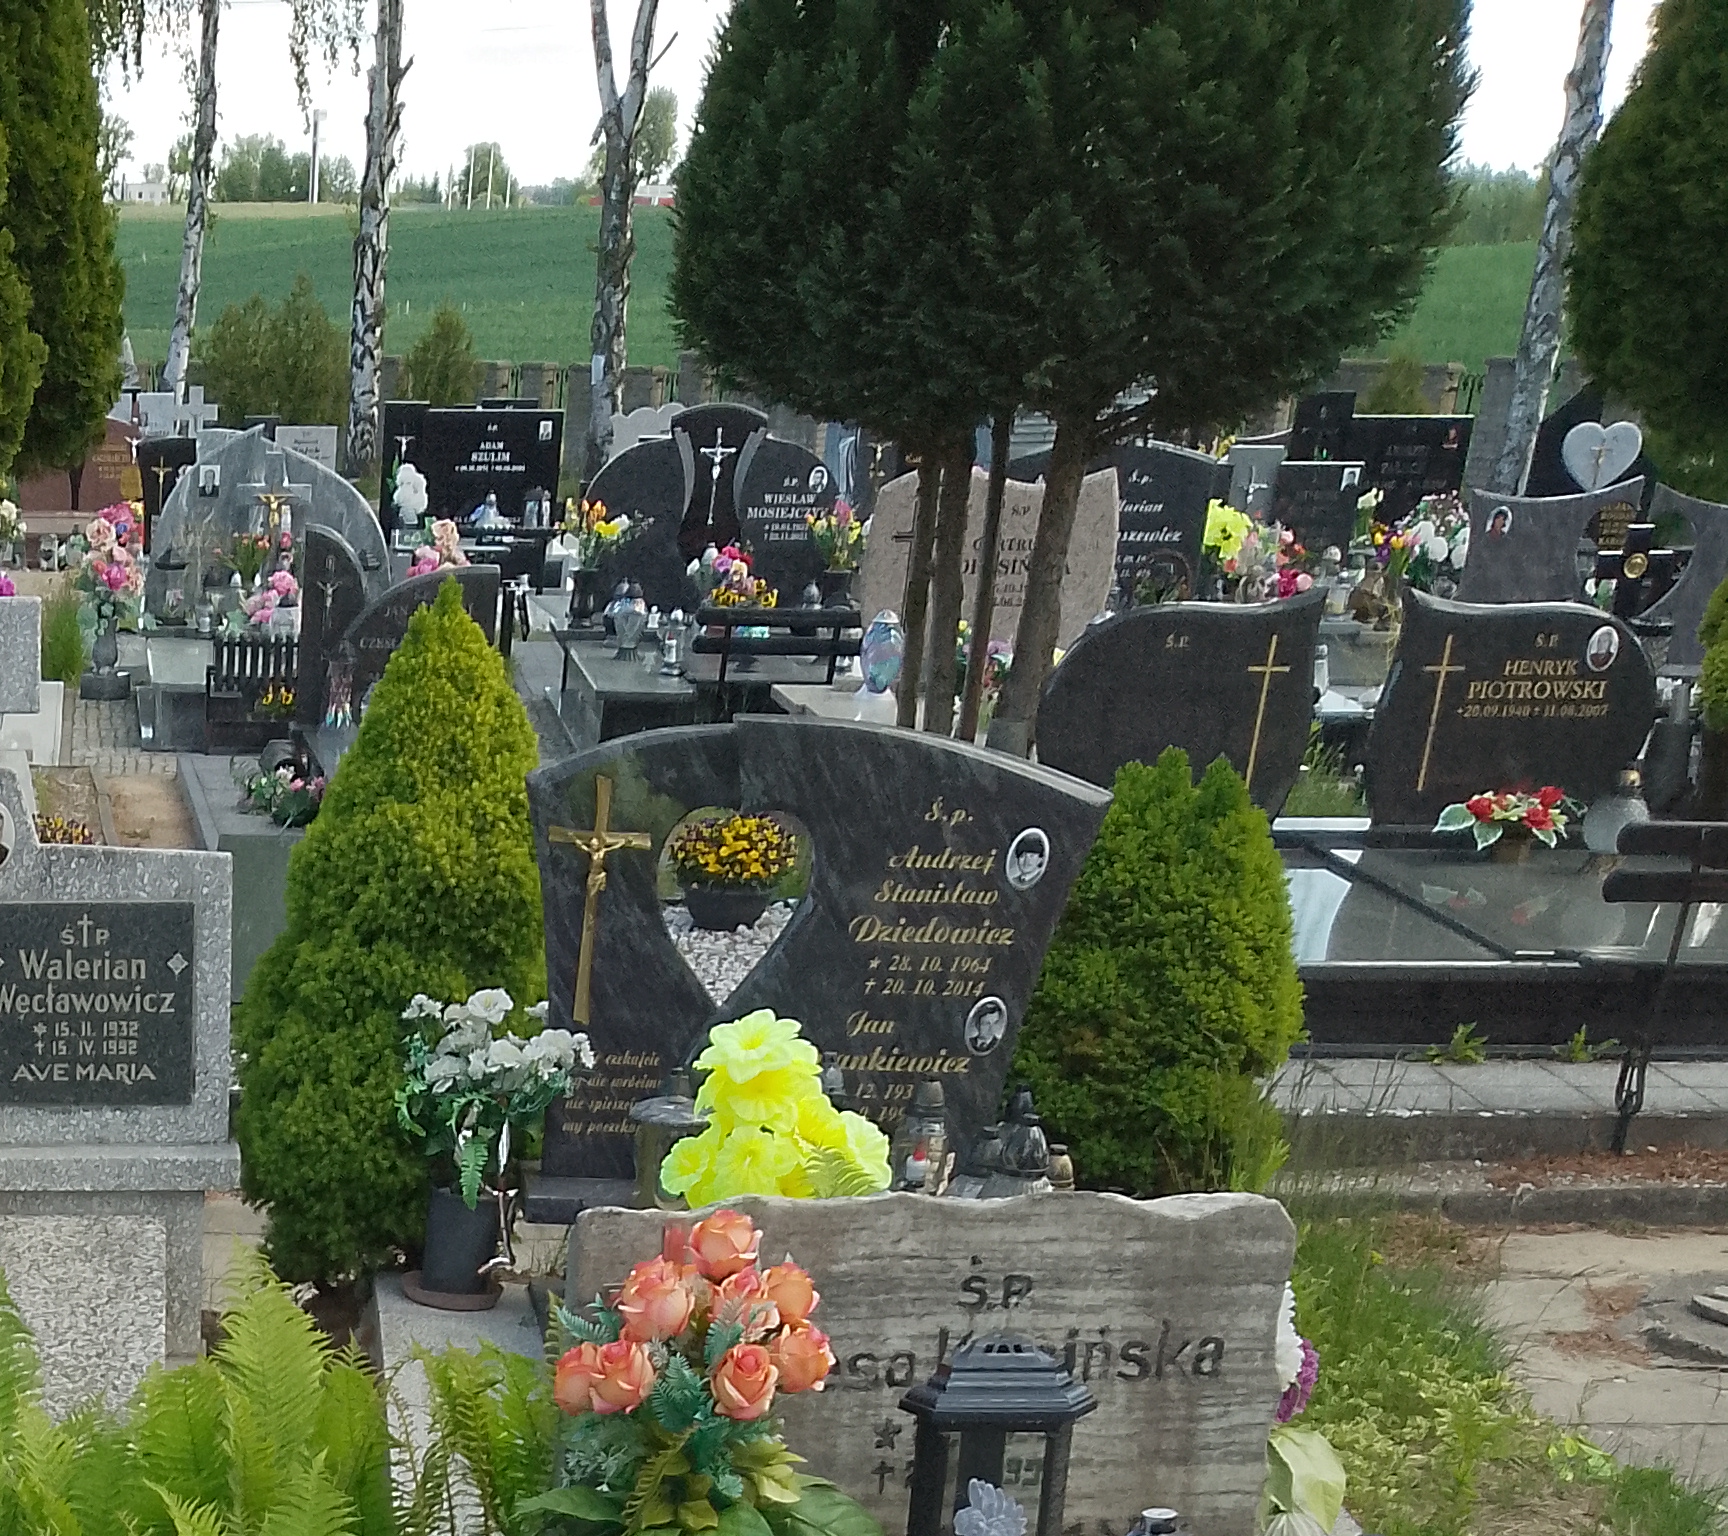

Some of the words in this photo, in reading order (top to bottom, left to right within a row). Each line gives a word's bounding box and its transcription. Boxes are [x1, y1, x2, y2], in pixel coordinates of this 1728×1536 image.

[1503, 659, 1579, 676] HENRYK
[1467, 680, 1608, 700] PIOTROWSKI
[888, 845, 999, 876] Andrzej
[874, 879, 1000, 905] Stanisław
[19, 949, 147, 981] Walerian
[888, 954, 913, 972] 28.
[920, 956, 943, 972] 10.
[950, 955, 993, 974] 1964
[881, 977, 905, 995] 20.
[913, 979, 937, 995] 10.
[942, 980, 986, 997] 2014
[103, 1020, 140, 1037] 1932
[846, 1010, 896, 1038] Jan
[102, 1040, 138, 1056] 1992
[11, 1062, 70, 1082] AVE
[75, 1062, 157, 1085] MARIA
